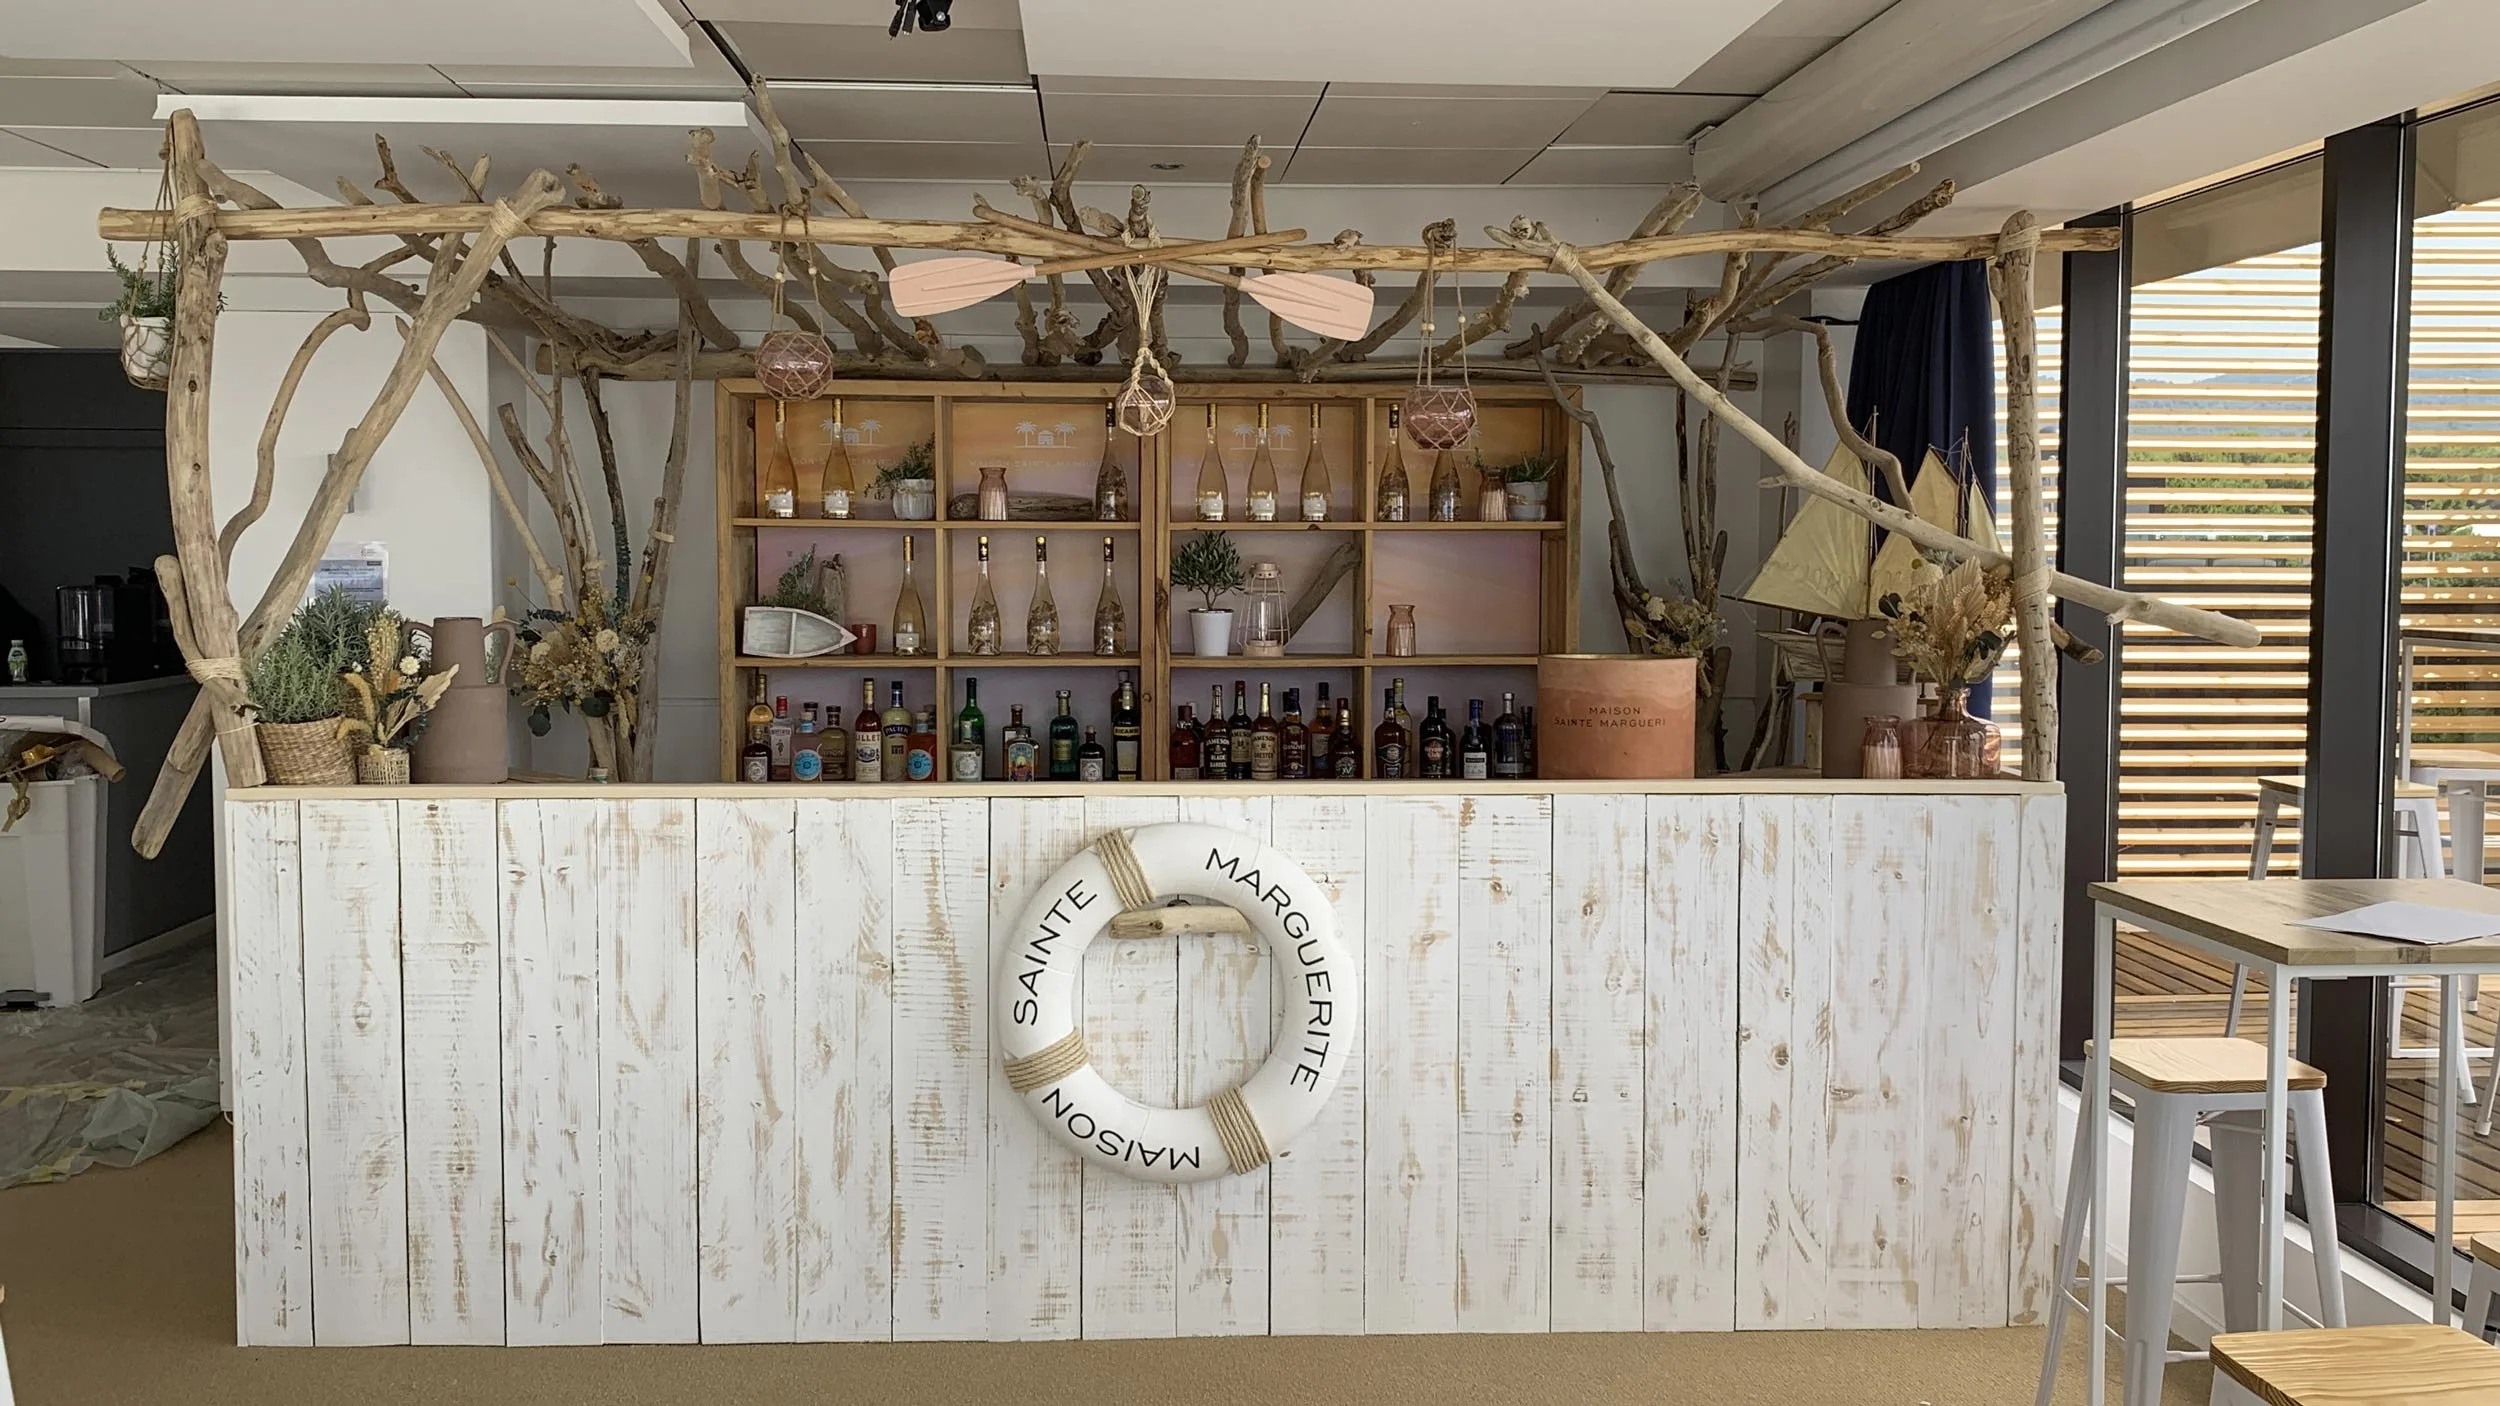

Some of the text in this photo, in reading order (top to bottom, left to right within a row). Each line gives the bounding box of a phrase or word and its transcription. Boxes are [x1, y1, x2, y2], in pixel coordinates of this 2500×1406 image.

[1588, 706, 1641, 716] MAISON
[1553, 717, 1593, 728] SAINTE
[1014, 848, 1333, 1171] MAISON SAINTE MARGUERITE
